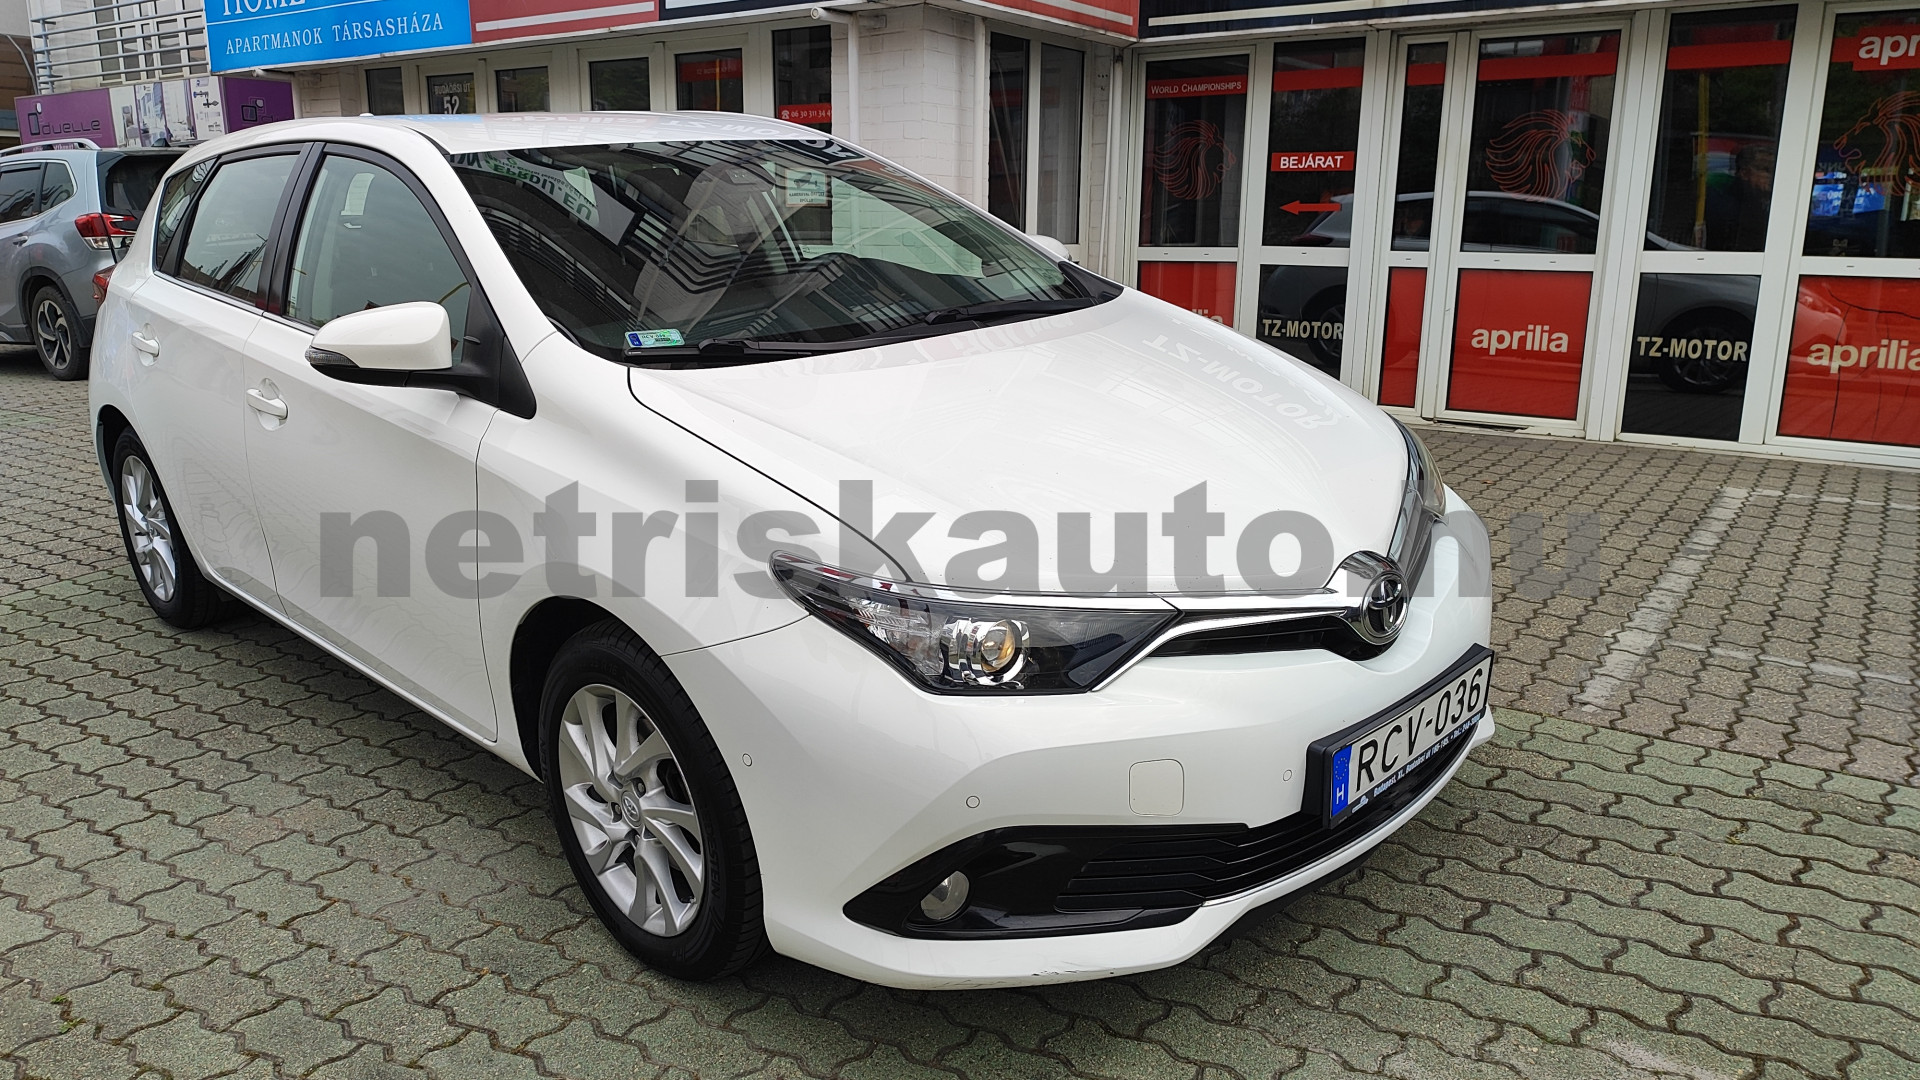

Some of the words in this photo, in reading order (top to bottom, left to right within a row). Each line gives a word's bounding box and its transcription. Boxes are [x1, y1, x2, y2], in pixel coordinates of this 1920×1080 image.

[225, 27, 323, 55] APARTMANOK
[331, 12, 444, 42] TÁRSASHÁZA
[1280, 154, 1343, 169] BEJÁRAT
[1262, 318, 1343, 341] TZ-MOTOR
[1471, 324, 1569, 356] aprilia
[1637, 336, 1748, 362] TZ-MOTOR
[1807, 338, 1920, 374] aprilia
[1355, 668, 1483, 793] RCV-036
[1336, 783, 1345, 805] H
